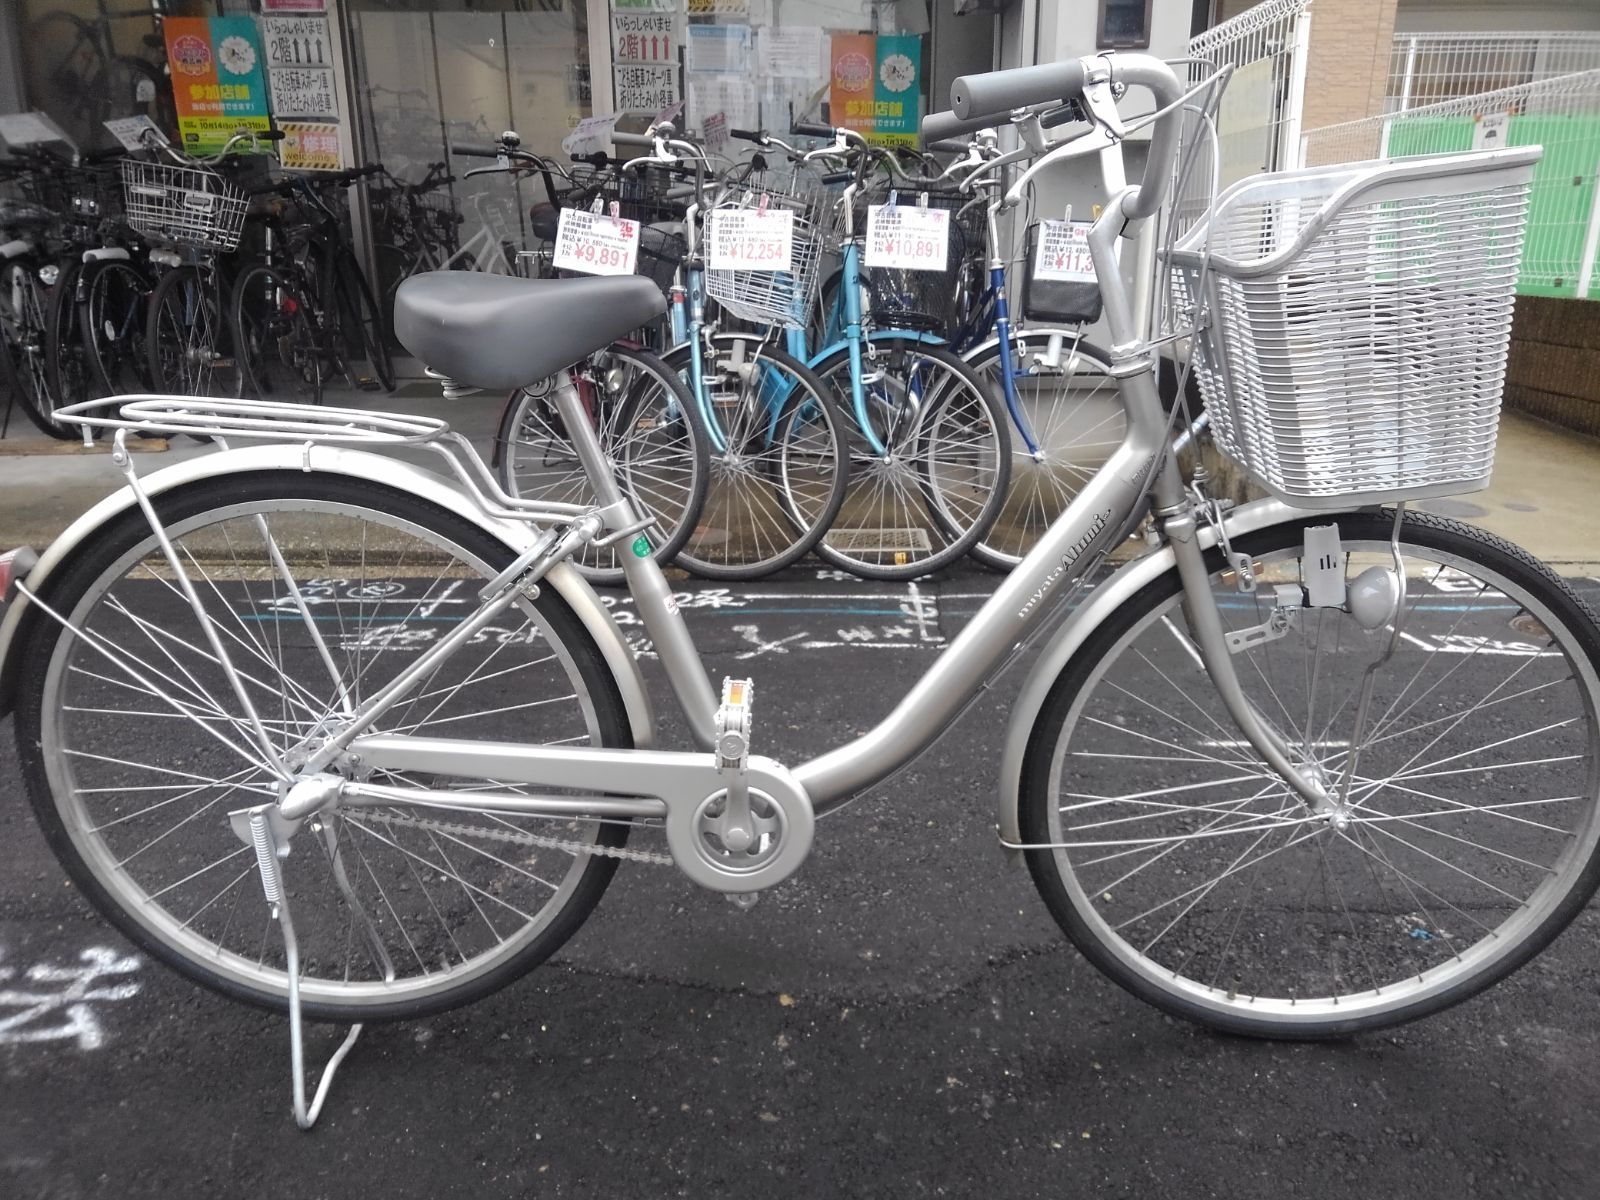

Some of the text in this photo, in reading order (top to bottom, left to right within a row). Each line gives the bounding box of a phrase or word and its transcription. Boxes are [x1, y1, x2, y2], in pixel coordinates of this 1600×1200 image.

[265, 20, 323, 35] いらっしゃいませ
[615, 16, 672, 32] いらっしゃいませ
[270, 38, 292, 63] 2階
[618, 34, 639, 60] 2階
[189, 84, 250, 100] 参加店舗
[276, 92, 332, 113] 折りたたみ小径車
[846, 101, 903, 117] 参加店舗
[303, 135, 338, 153] 修理
[575, 243, 629, 268] ¥9,891
[729, 241, 783, 260] ¥12,254
[885, 239, 940, 260] ¥10,891
[1018, 565, 1064, 618] miyata
